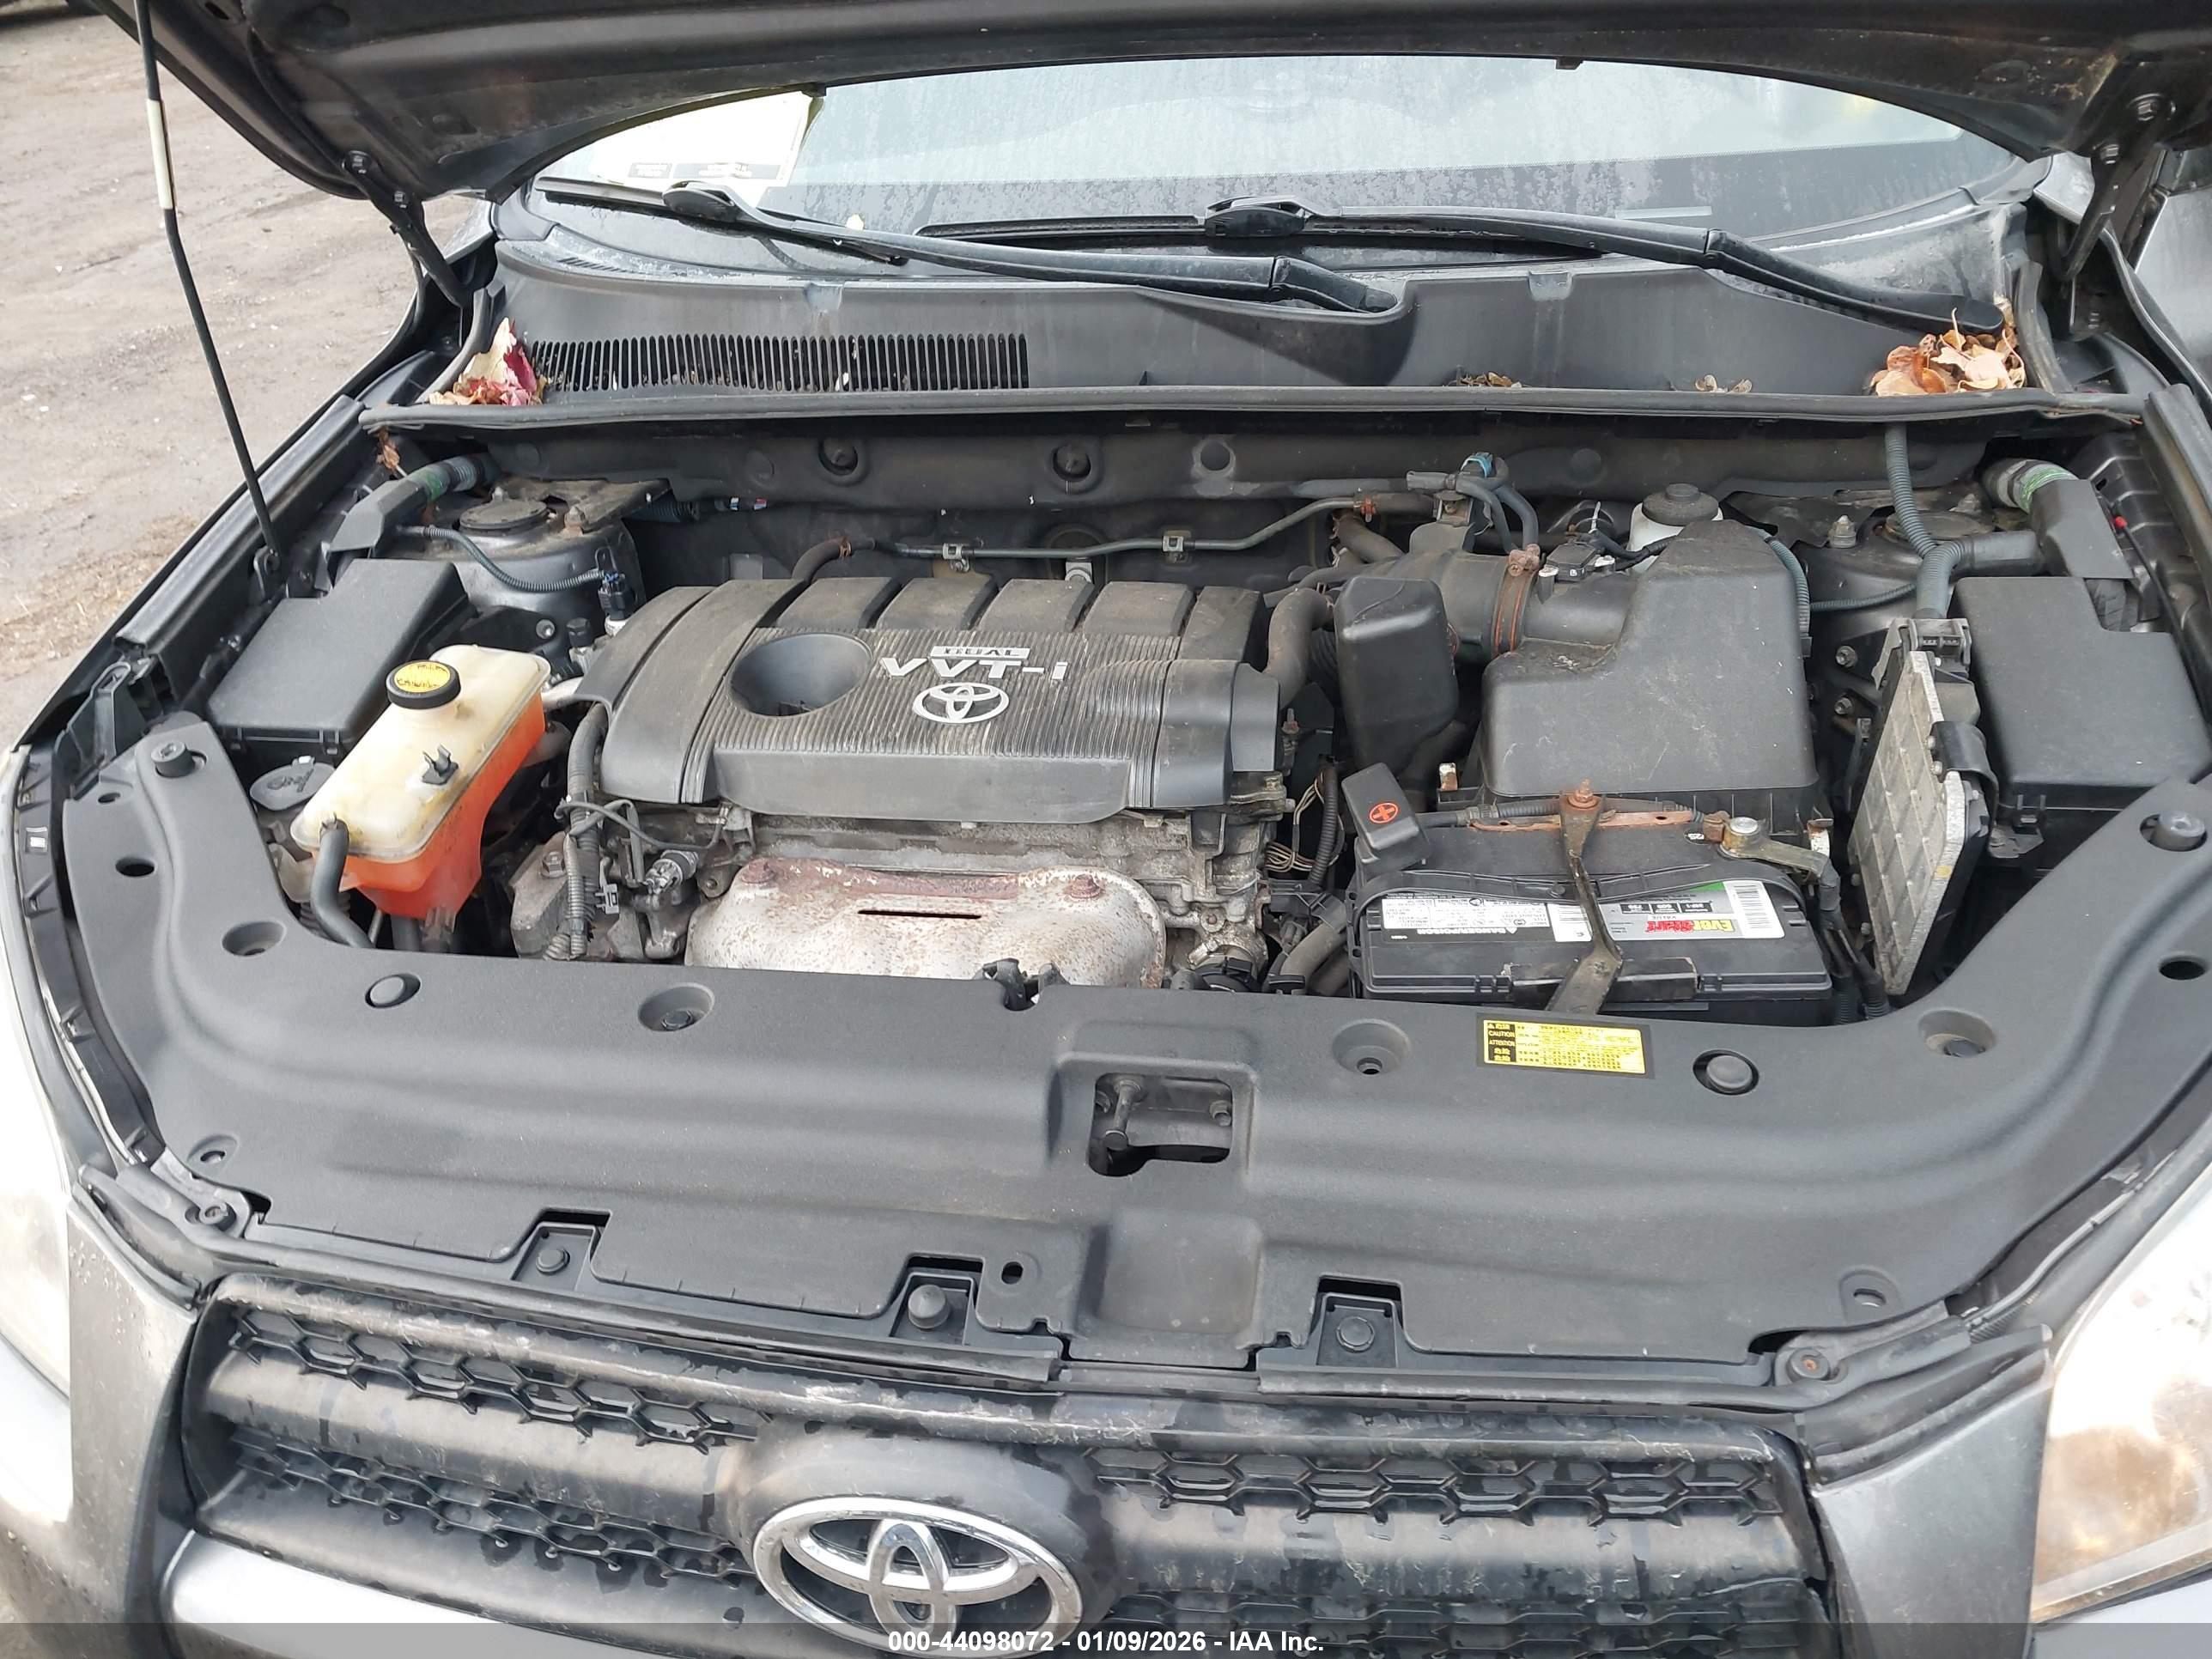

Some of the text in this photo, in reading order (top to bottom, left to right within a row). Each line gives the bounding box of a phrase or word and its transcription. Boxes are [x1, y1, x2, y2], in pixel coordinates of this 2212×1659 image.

[942, 647, 1021, 657] DUAL
[880, 657, 1069, 681] VVT-i
[1646, 920, 1733, 932] EverStart
